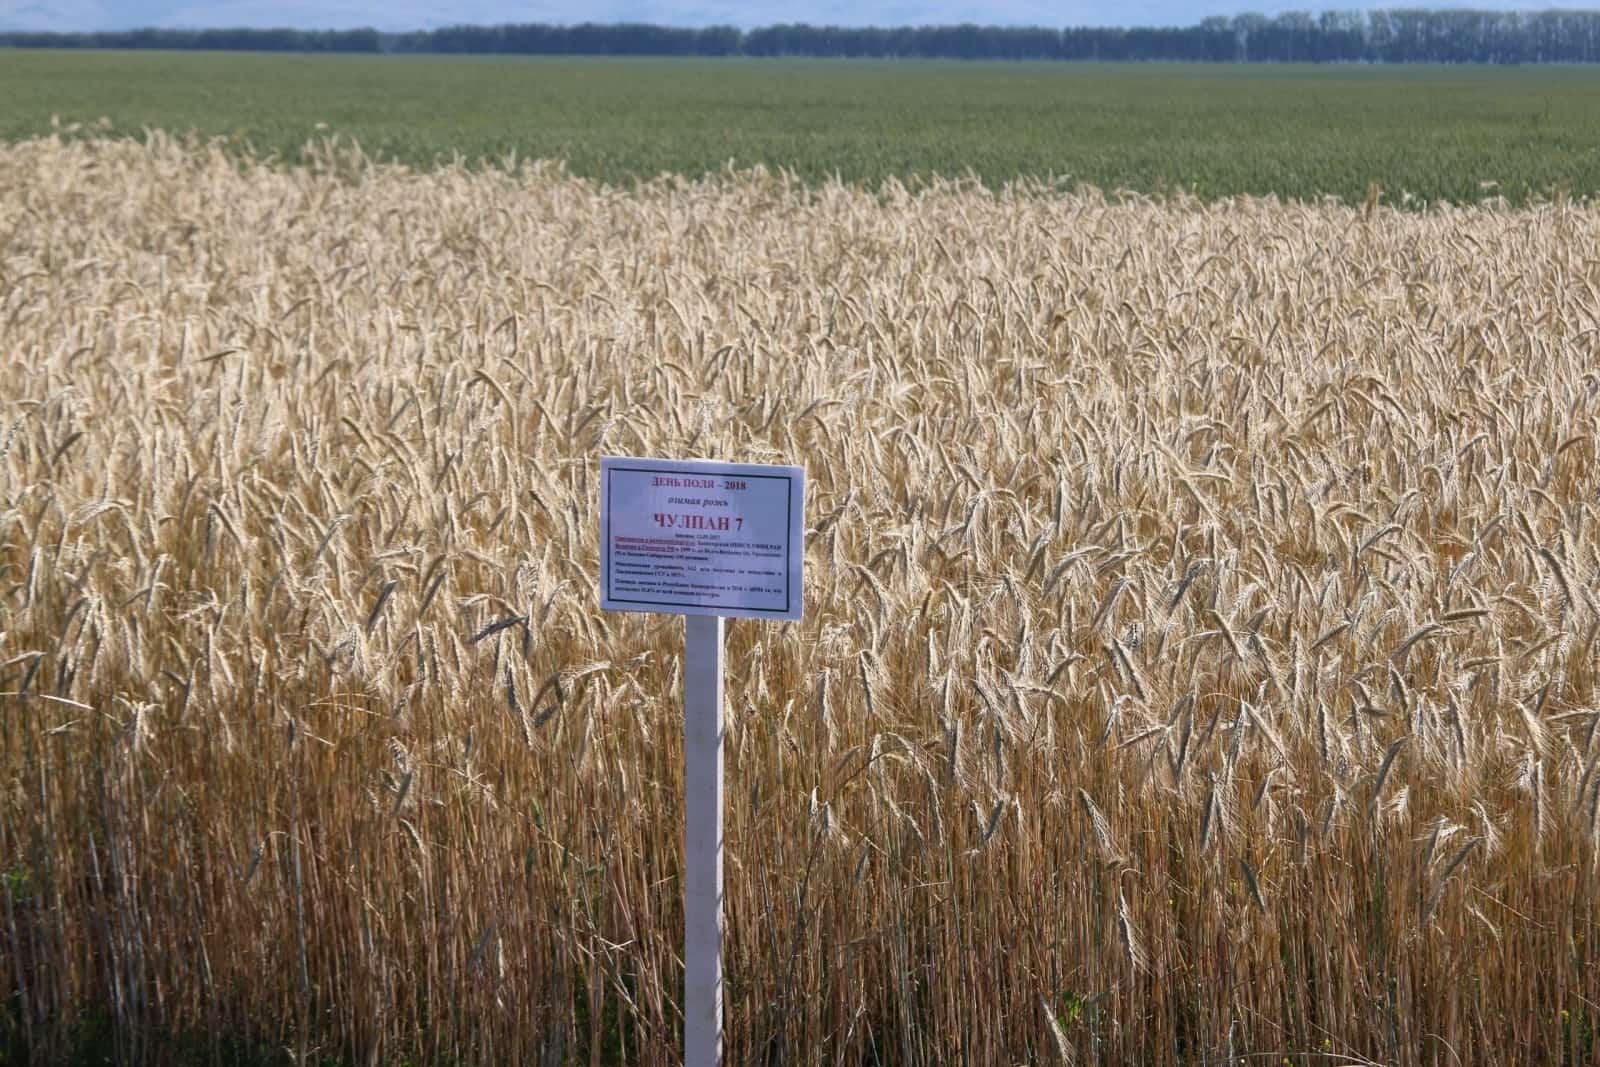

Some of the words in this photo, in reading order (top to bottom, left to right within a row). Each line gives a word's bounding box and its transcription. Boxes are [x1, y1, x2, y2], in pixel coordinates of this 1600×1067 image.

[652, 477, 680, 488] ДЕНЬ
[683, 479, 715, 489] ПОЛЯ
[725, 480, 747, 490] 2018
[668, 496, 701, 505] озимая
[702, 498, 729, 508] рожь
[654, 512, 730, 531] ЧУЛПАН
[736, 517, 744, 531] 7
